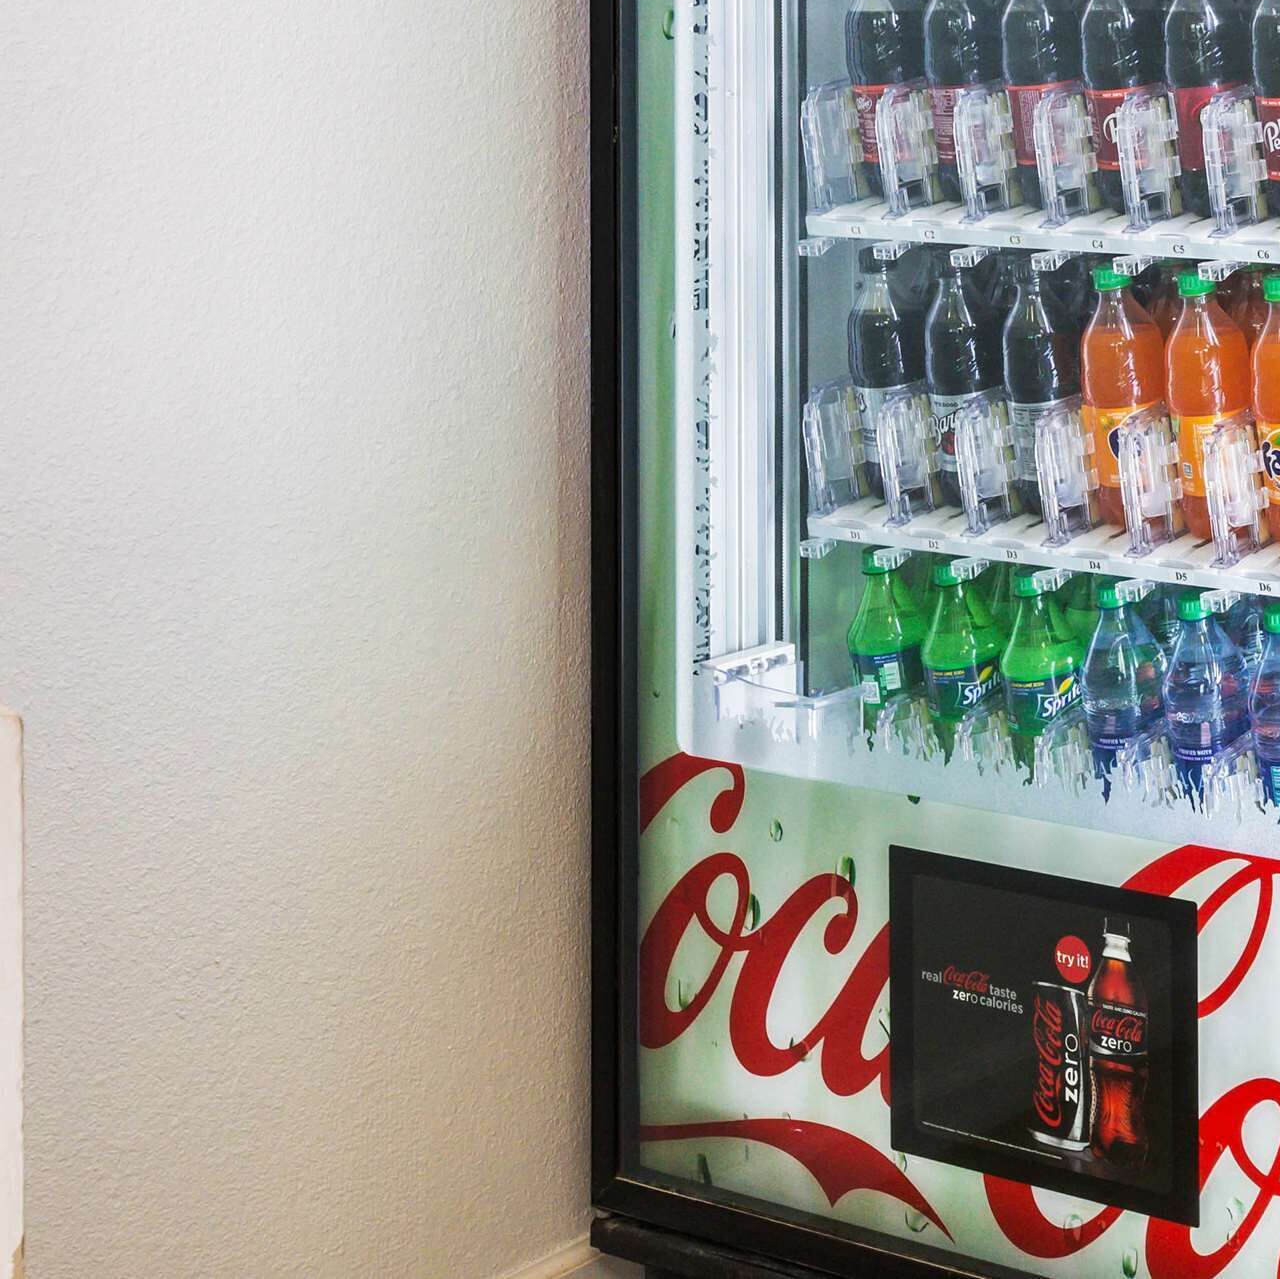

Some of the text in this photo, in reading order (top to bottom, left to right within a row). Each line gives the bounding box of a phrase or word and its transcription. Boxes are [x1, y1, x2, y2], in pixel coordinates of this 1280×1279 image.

[1092, 240, 1103, 248] C4
[1175, 572, 1187, 581] D5
[1056, 950, 1089, 969] try it!
[921, 965, 1017, 1000] real Coca-Cola taste
[952, 990, 1024, 1014] zero calories
[1091, 1009, 1143, 1042] Coca-Cola
[1101, 1034, 1132, 1053] zero
[1032, 993, 1062, 1128] Coca-Cola
[1065, 1033, 1078, 1104] zero
